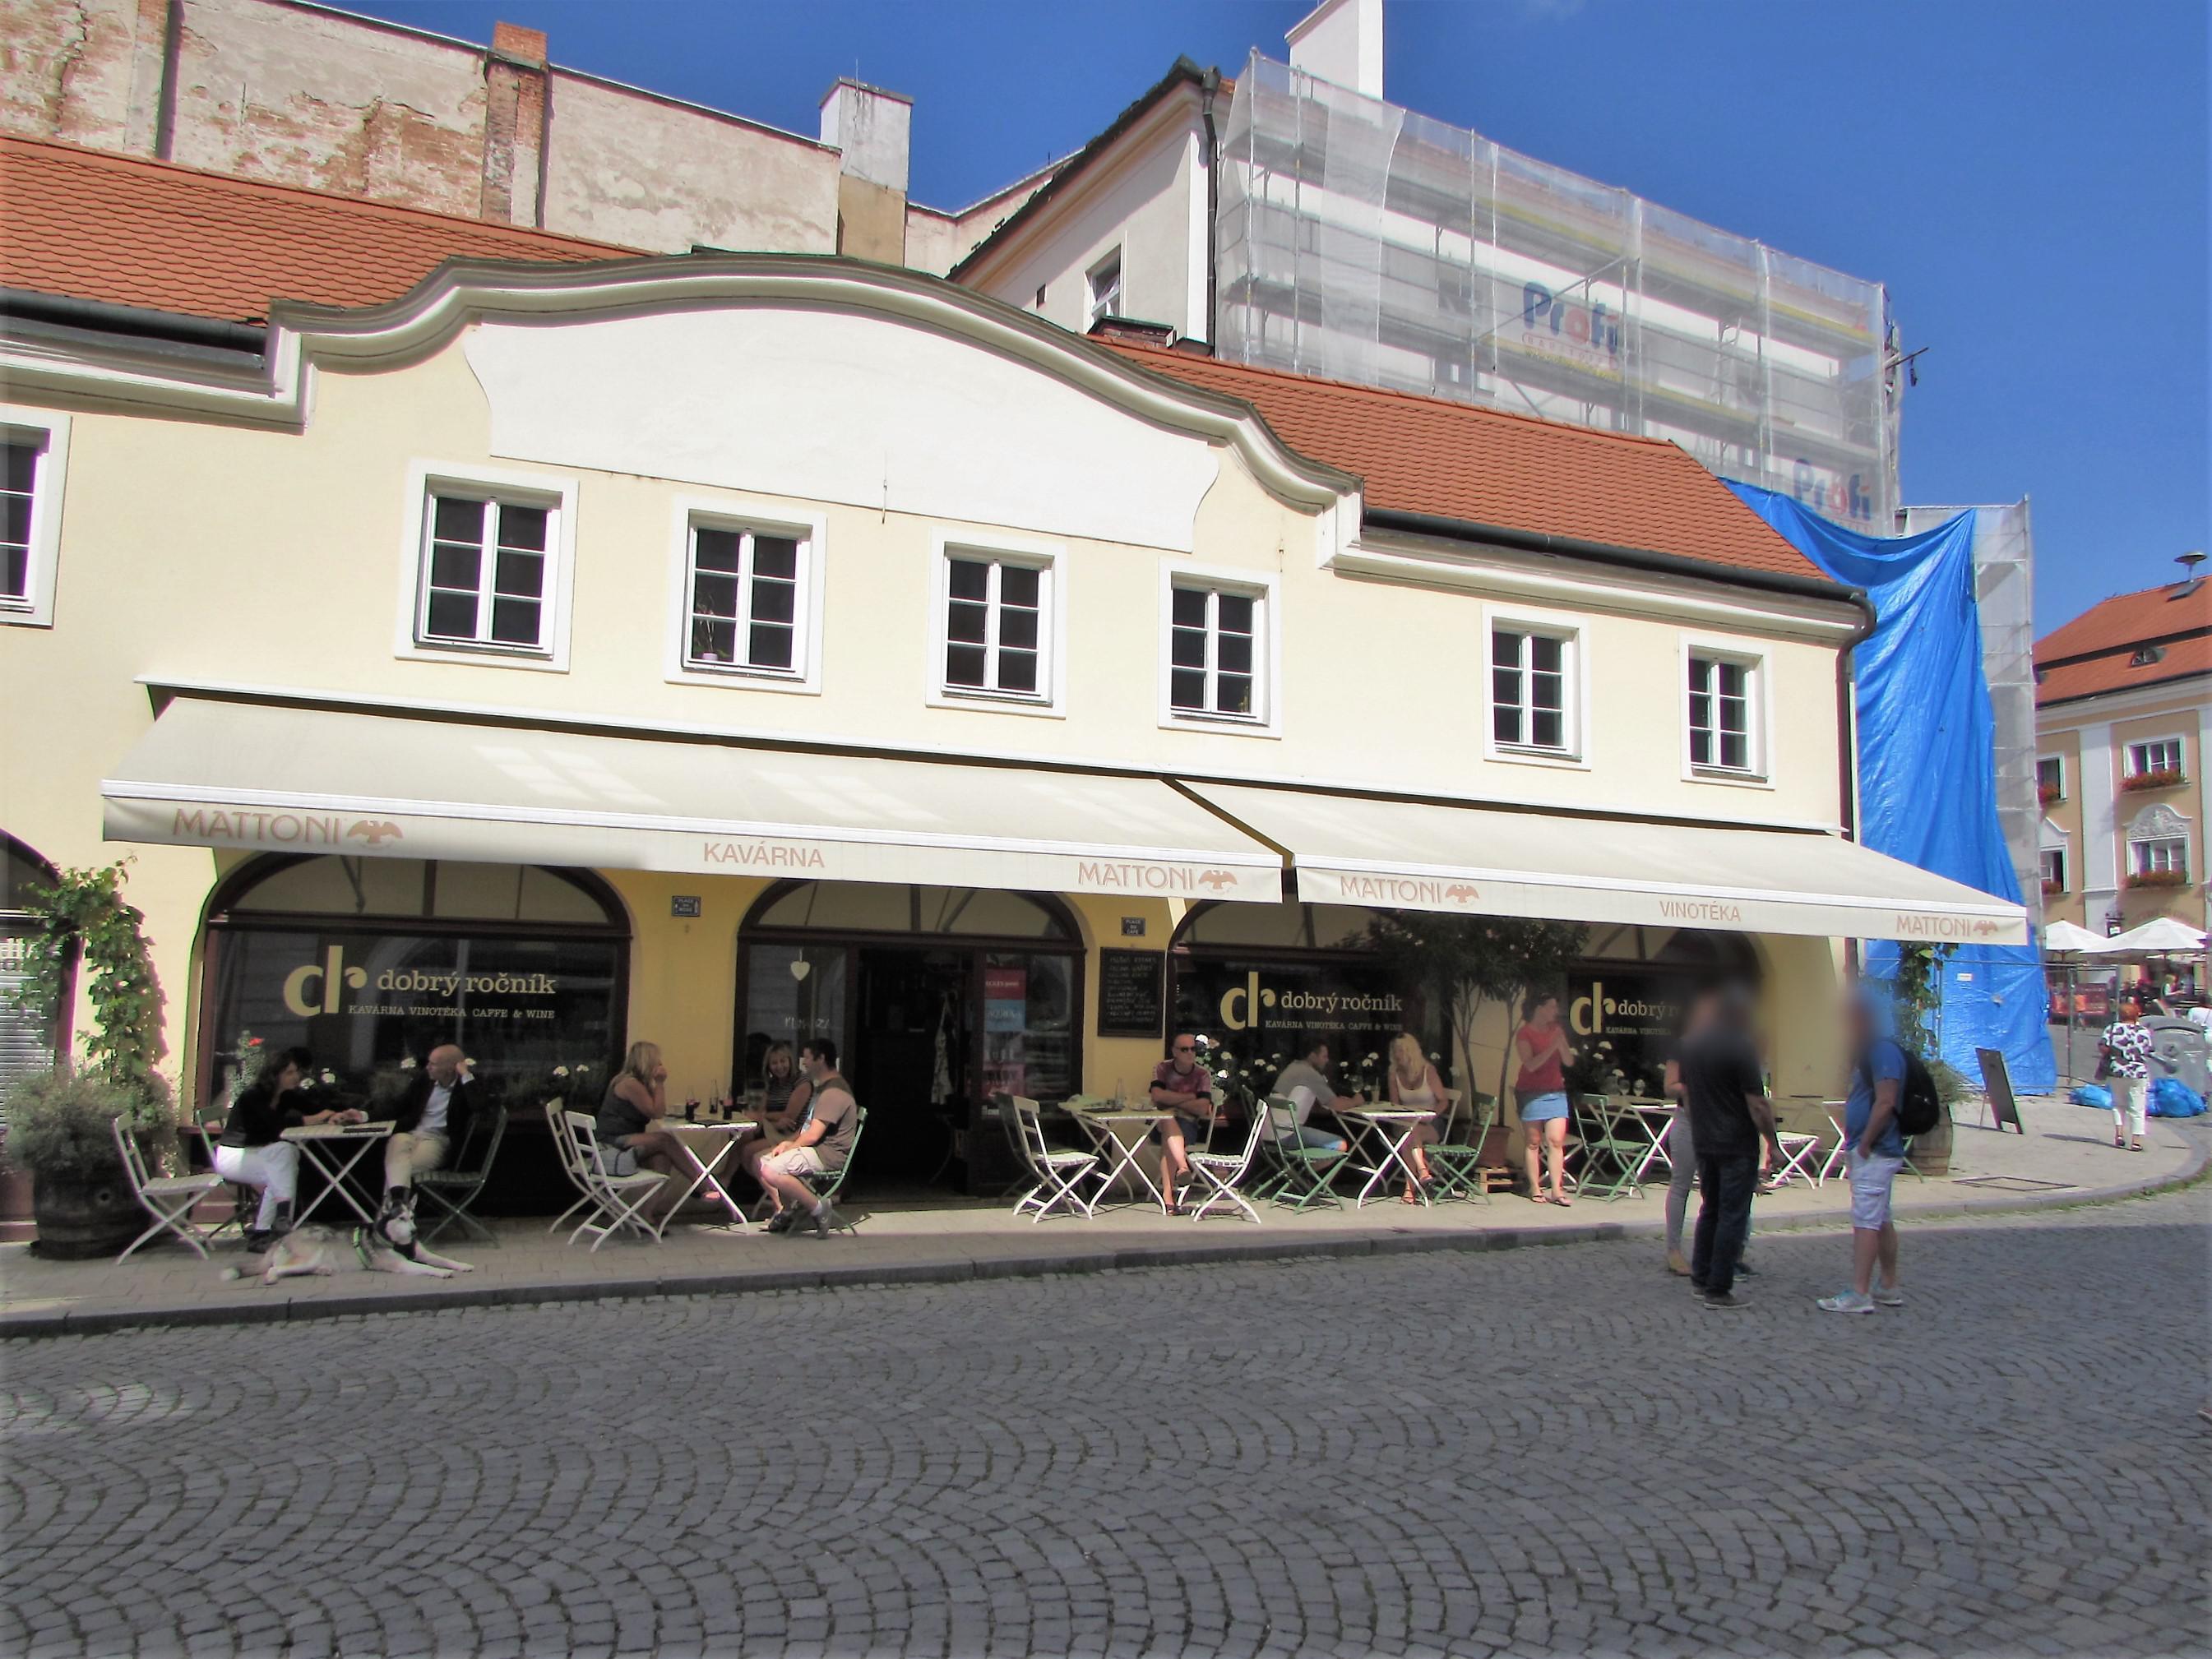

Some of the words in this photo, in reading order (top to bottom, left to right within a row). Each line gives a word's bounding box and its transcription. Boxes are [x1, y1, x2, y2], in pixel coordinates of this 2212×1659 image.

[1524, 282, 1618, 354] Profi
[1793, 459, 1870, 521] Profi
[172, 807, 340, 844] MATTONI
[703, 840, 826, 868] KAVÁRNA
[1078, 862, 1193, 890] MATTONI
[1340, 876, 1441, 903] MATTONI
[1659, 901, 1742, 922] VINOTÉKA
[1895, 915, 1971, 936] MATTONI
[377, 969, 461, 997] dobrý
[465, 972, 556, 994] ročník
[348, 1005, 405, 1015] KAVÁRNA
[409, 1005, 467, 1017] VINOTÉKA
[472, 1008, 508, 1018] CAFFE
[513, 1010, 523, 1019] &
[525, 1010, 555, 1019] WINE
[1281, 991, 1338, 1014] dobrý
[1341, 994, 1403, 1012] ročník
[1618, 1000, 1666, 1020] dobrý
